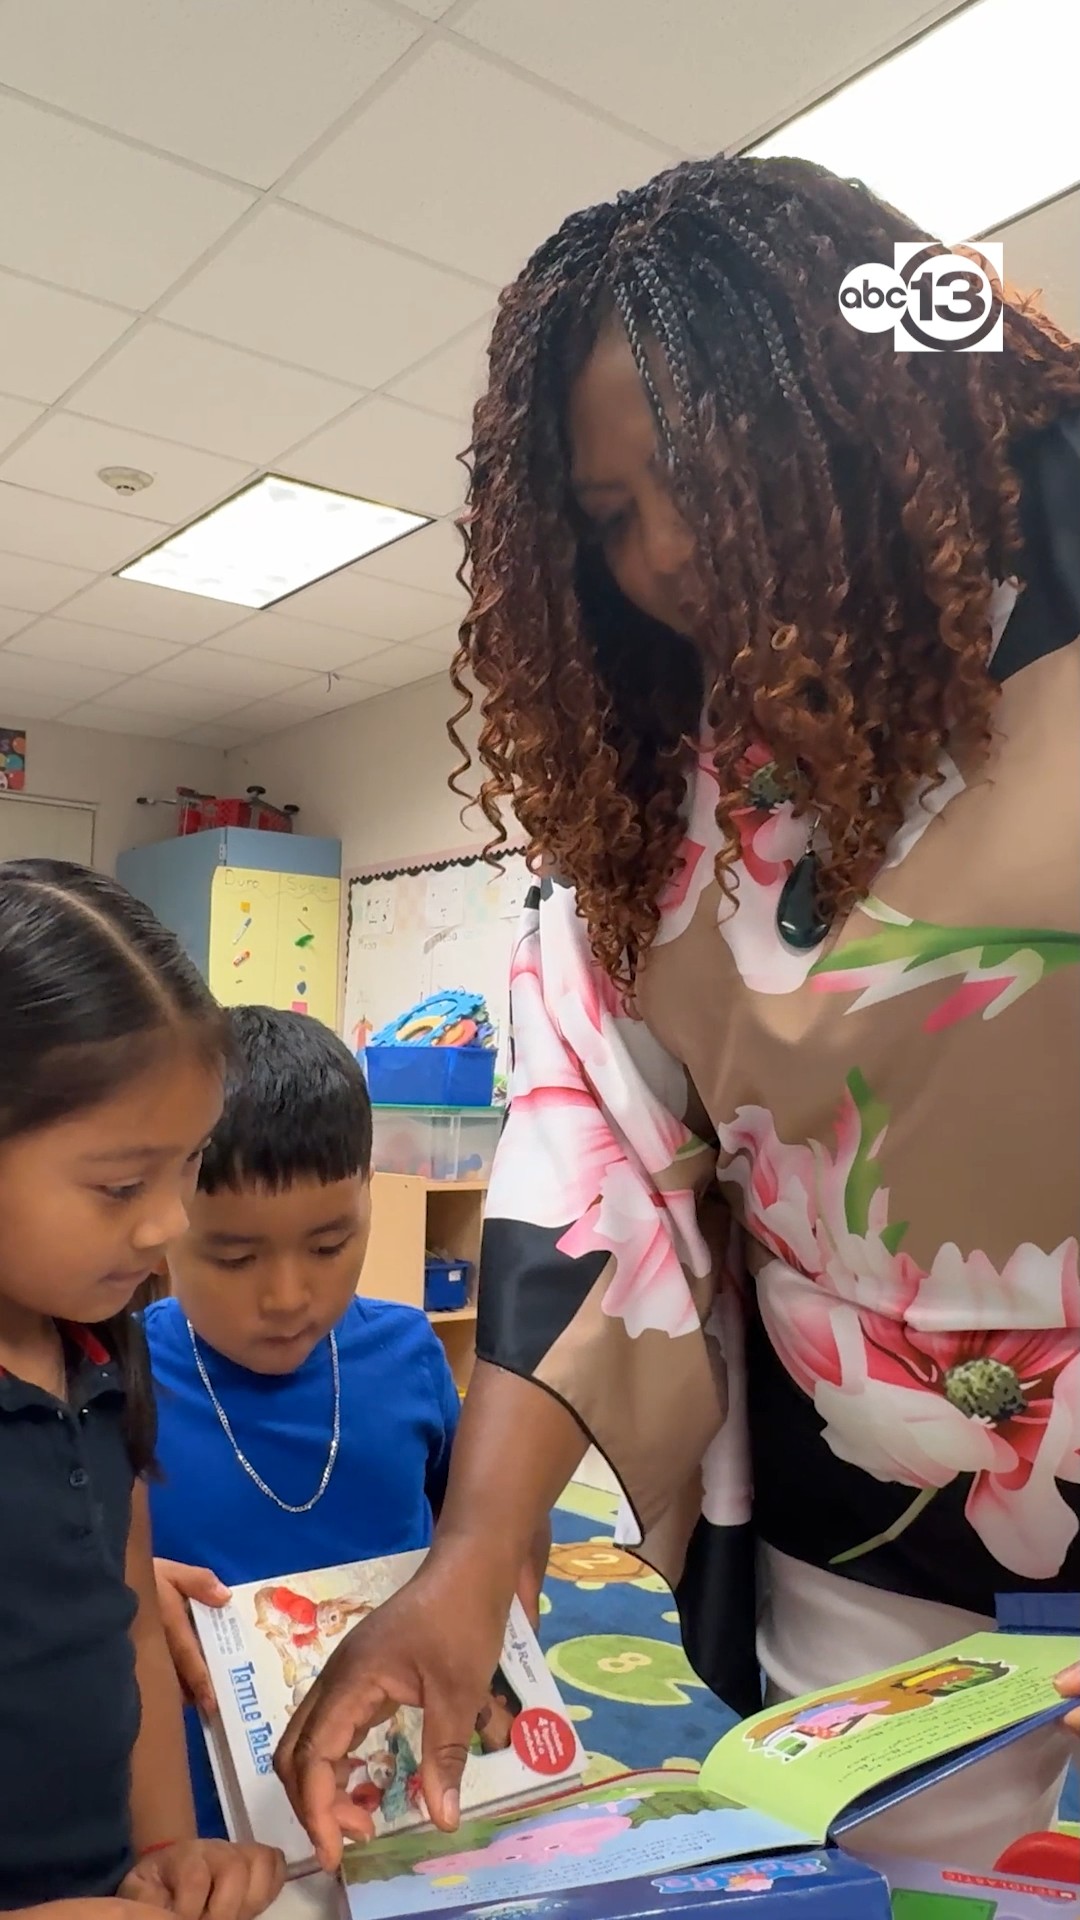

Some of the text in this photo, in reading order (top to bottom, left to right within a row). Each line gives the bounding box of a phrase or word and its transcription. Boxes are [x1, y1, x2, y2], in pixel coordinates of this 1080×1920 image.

[224, 869, 260, 889] Duro
[571, 1553, 620, 1569] 2
[597, 1651, 652, 1674] 8
[943, 1872, 1060, 1898] SCHOLASTIC
